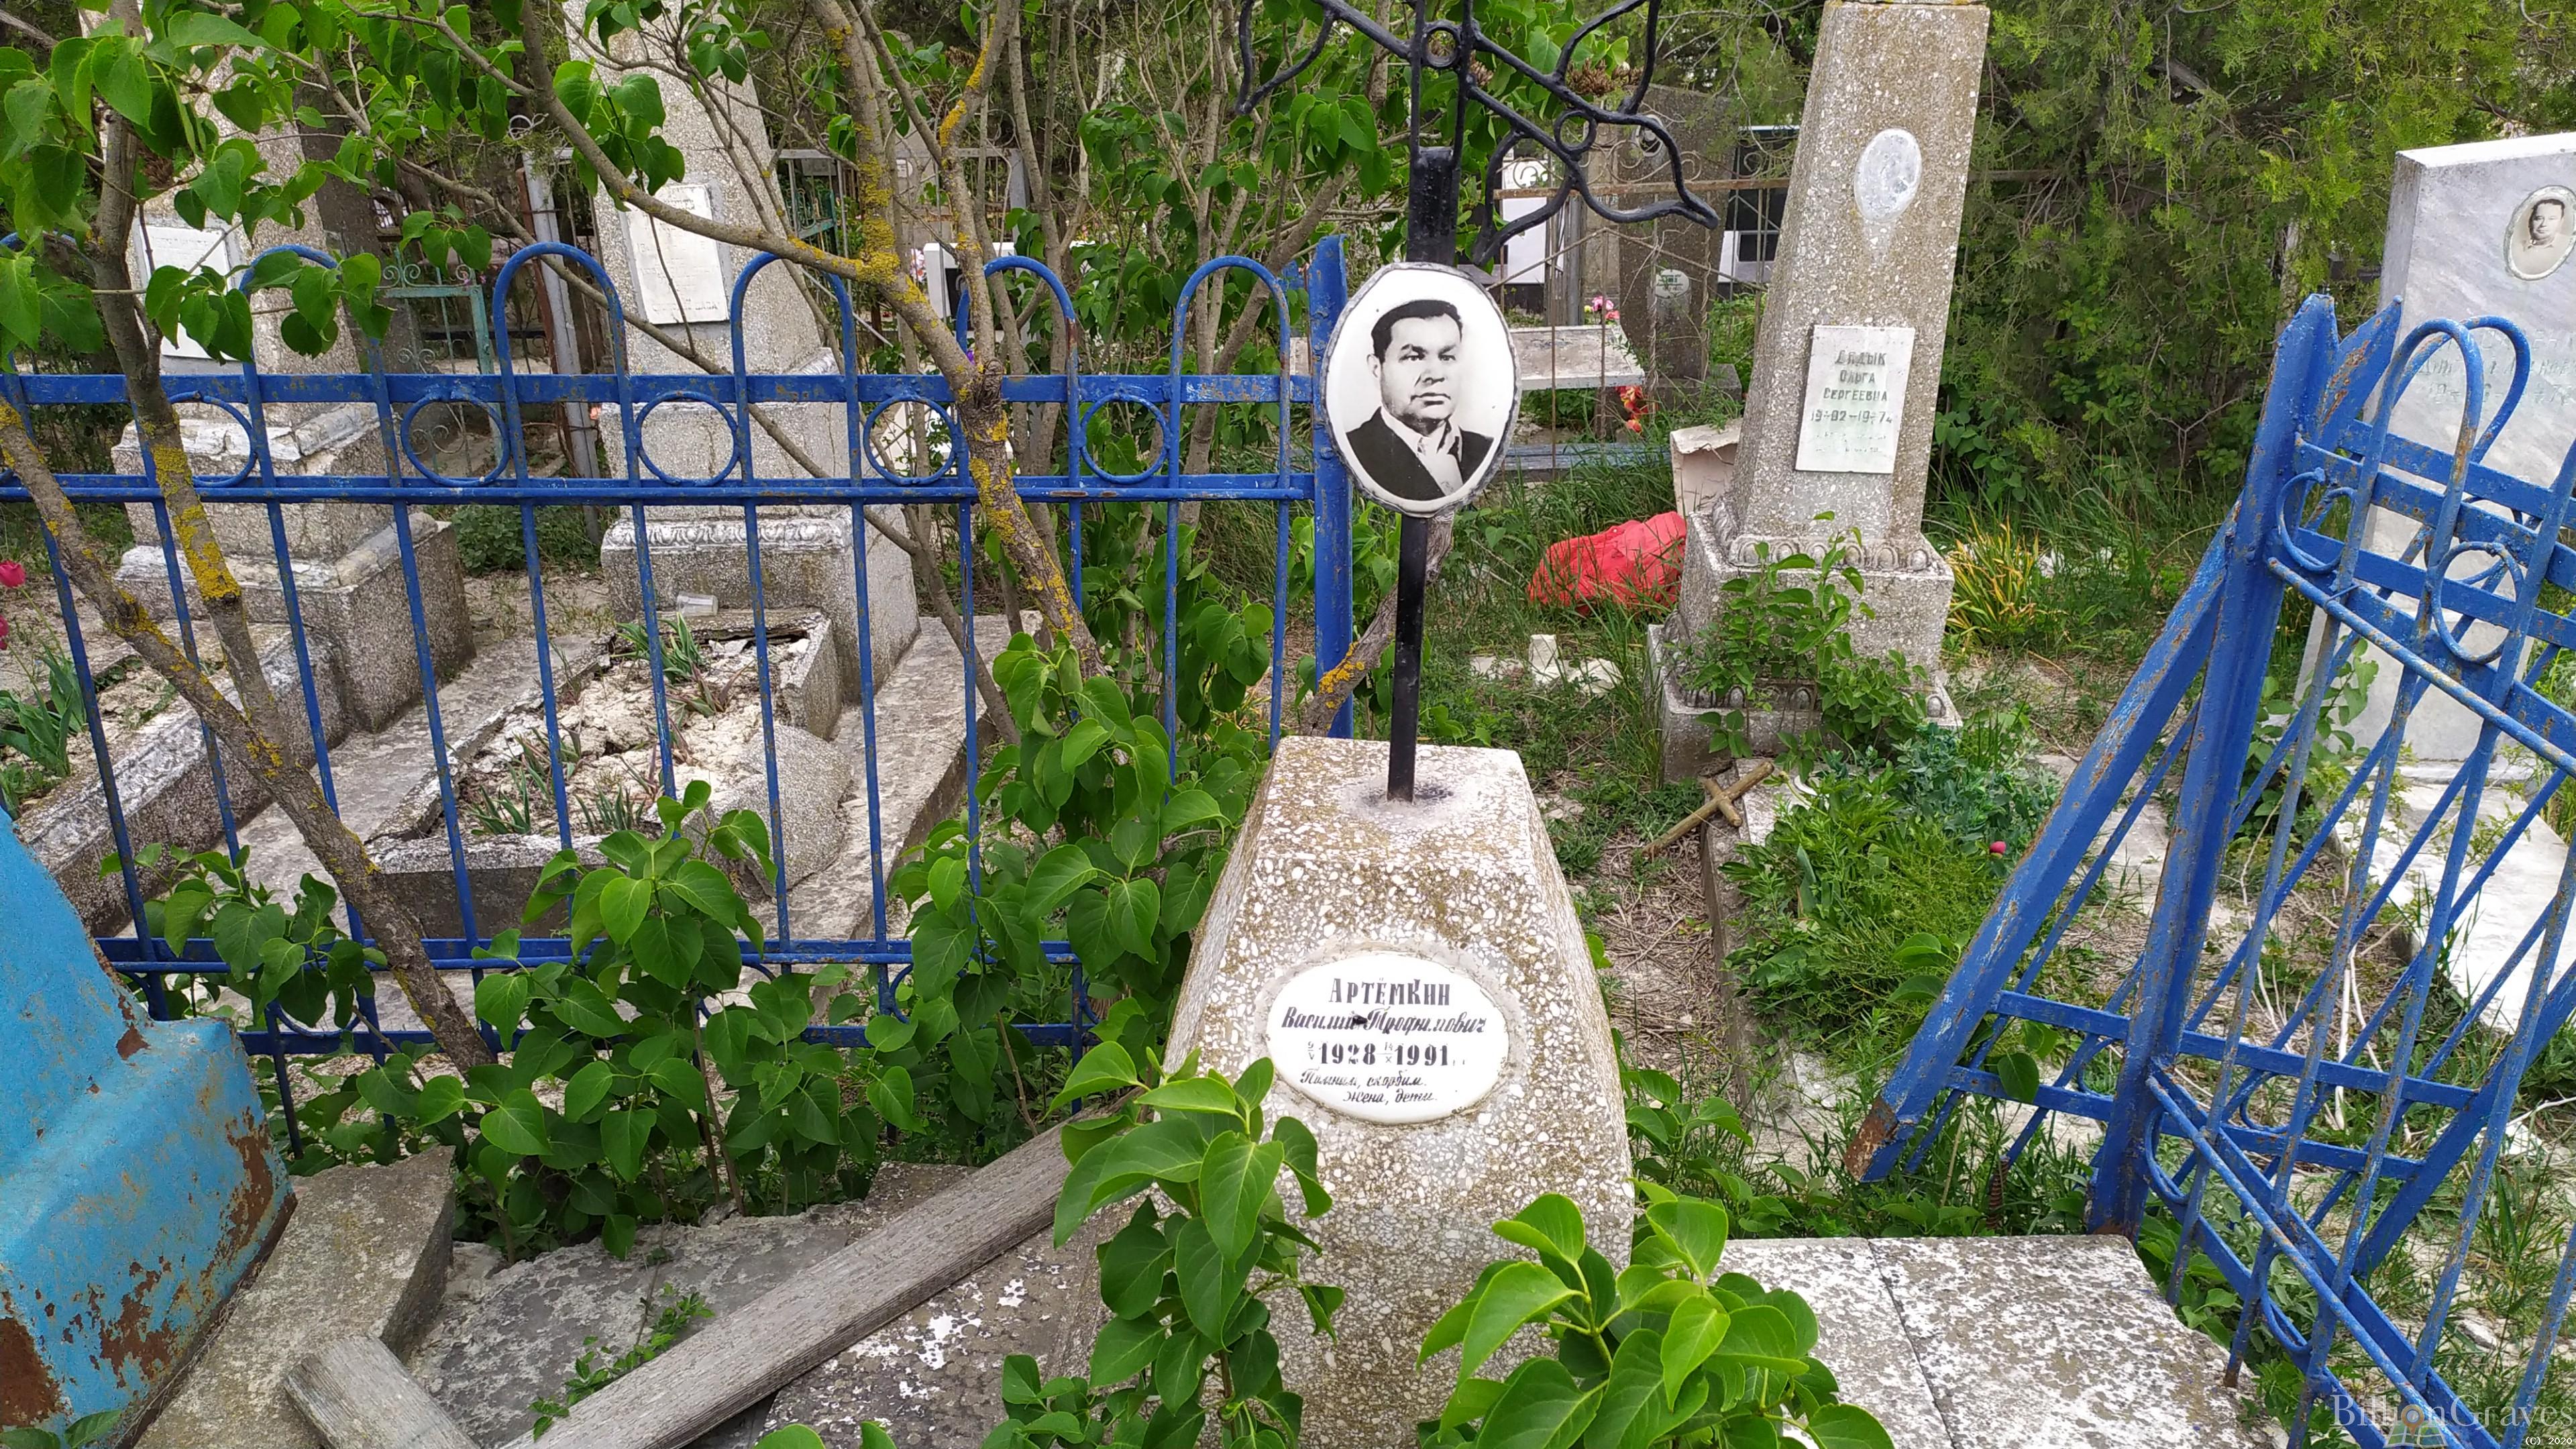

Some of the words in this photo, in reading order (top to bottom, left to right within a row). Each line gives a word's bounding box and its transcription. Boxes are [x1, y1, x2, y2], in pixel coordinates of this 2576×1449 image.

[1839, 370, 1876, 384] ОЛЬГА
[1363, 1006, 1487, 1036] Трофимович
[1319, 1042, 1376, 1065] 1928
[1395, 1043, 1448, 1067] 1991
